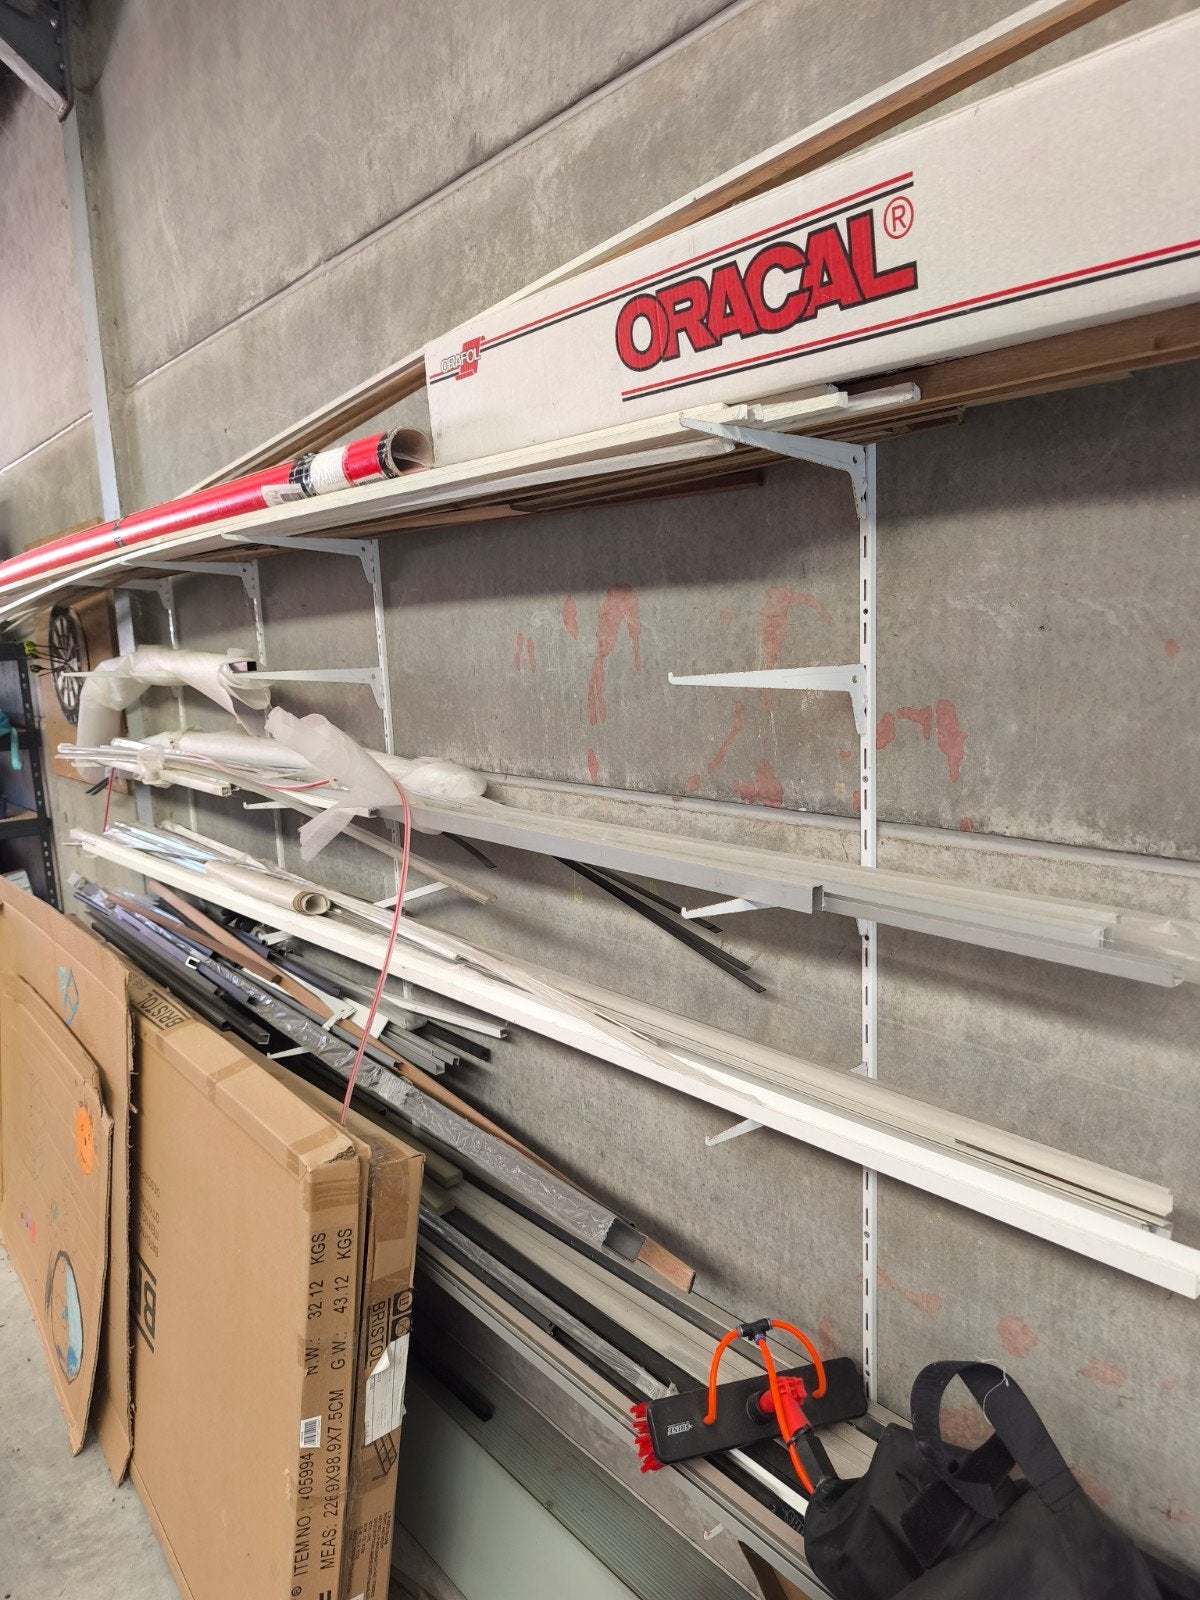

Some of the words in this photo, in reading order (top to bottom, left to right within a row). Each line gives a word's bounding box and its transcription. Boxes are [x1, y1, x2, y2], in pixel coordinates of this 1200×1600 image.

[137, 993, 184, 1028] BRISTOL
[311, 1232, 326, 1265] KGS
[337, 1228, 352, 1260] KGS
[308, 1280, 324, 1320] 32.12
[333, 1275, 349, 1314] 43.12
[331, 1332, 347, 1370] G.W.:
[369, 1301, 385, 1368] BRISTOL
[294, 1539, 309, 1577] ITEM
[320, 1524, 337, 1570] MEAS:
